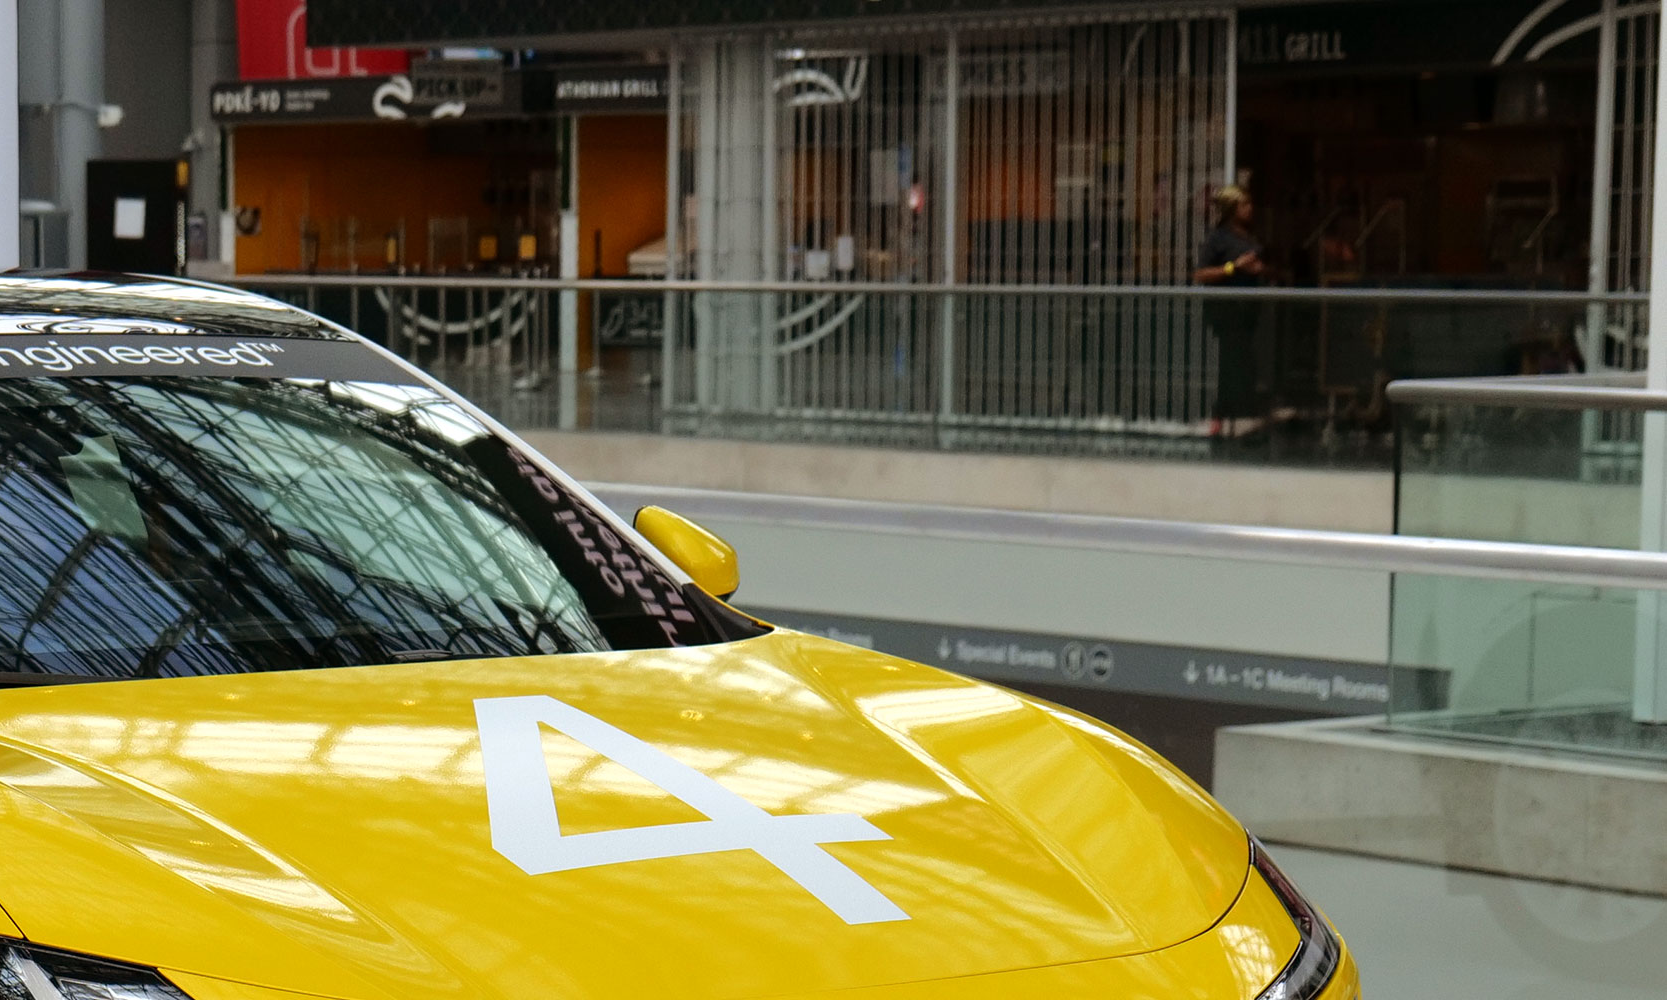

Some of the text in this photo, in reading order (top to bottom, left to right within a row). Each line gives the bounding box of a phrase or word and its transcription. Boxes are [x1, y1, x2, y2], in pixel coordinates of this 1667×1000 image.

[1285, 30, 1347, 61] GRILL
[956, 639, 1057, 669] Special Events
[1267, 669, 1331, 700] Meeting
[1332, 675, 1389, 702] Rooms
[473, 694, 912, 925] 4
